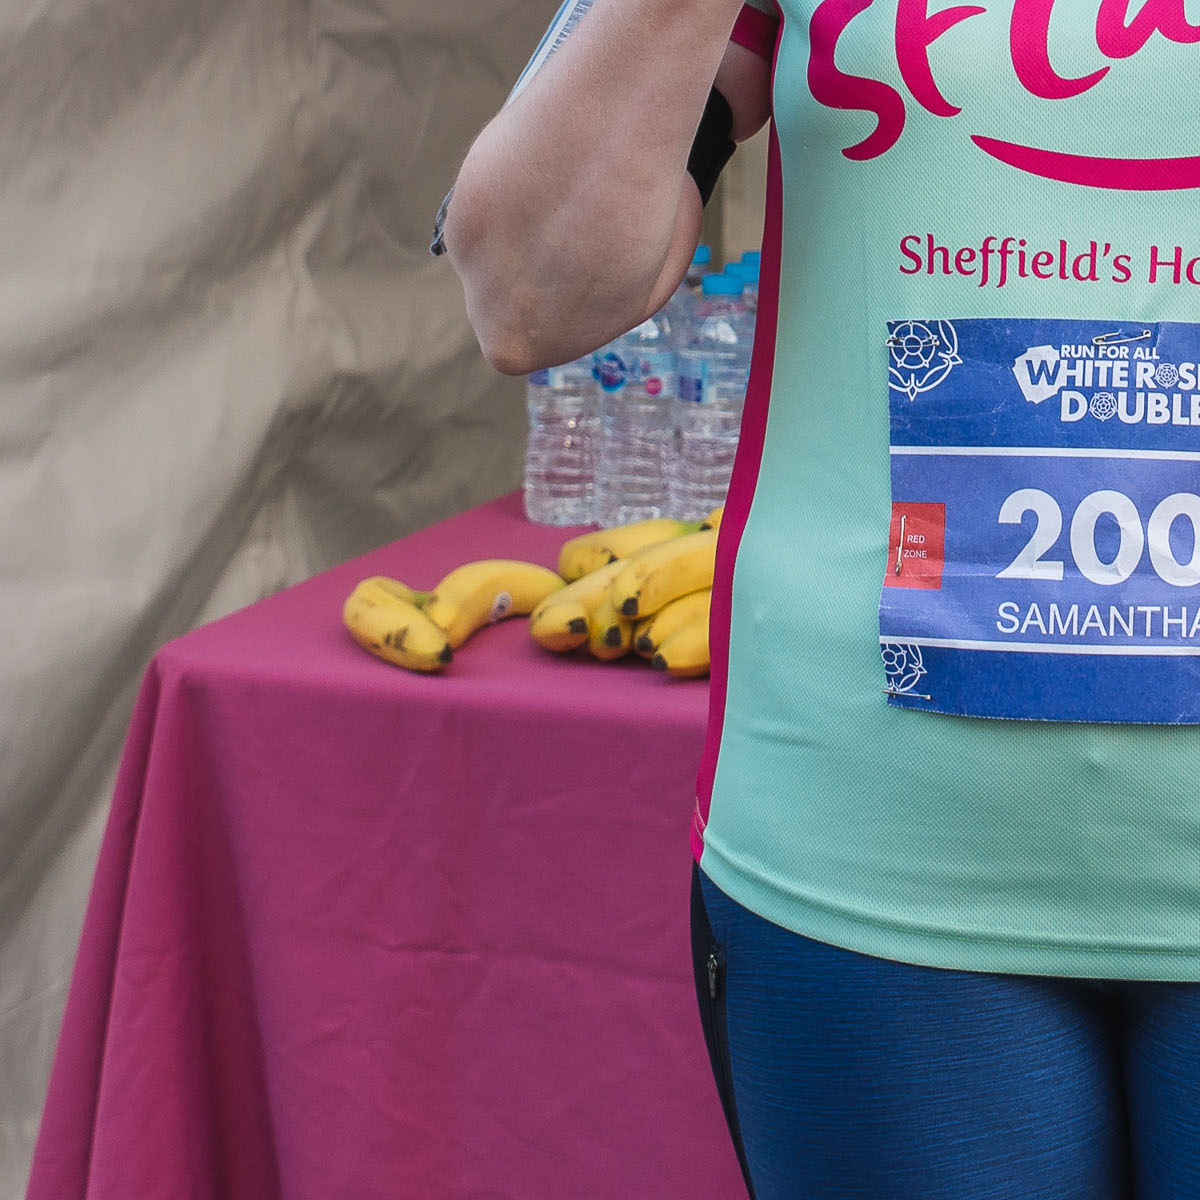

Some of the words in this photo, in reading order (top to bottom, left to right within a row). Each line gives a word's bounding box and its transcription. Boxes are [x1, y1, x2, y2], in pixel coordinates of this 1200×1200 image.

[898, 234, 1133, 289] Sheffield's
[1060, 344, 1095, 359] RUN
[1098, 345, 1129, 360] FOR
[1133, 346, 1160, 360] ALL
[1025, 359, 1129, 388] WHITE
[906, 534, 926, 544] RED
[903, 549, 928, 559] ZONE
